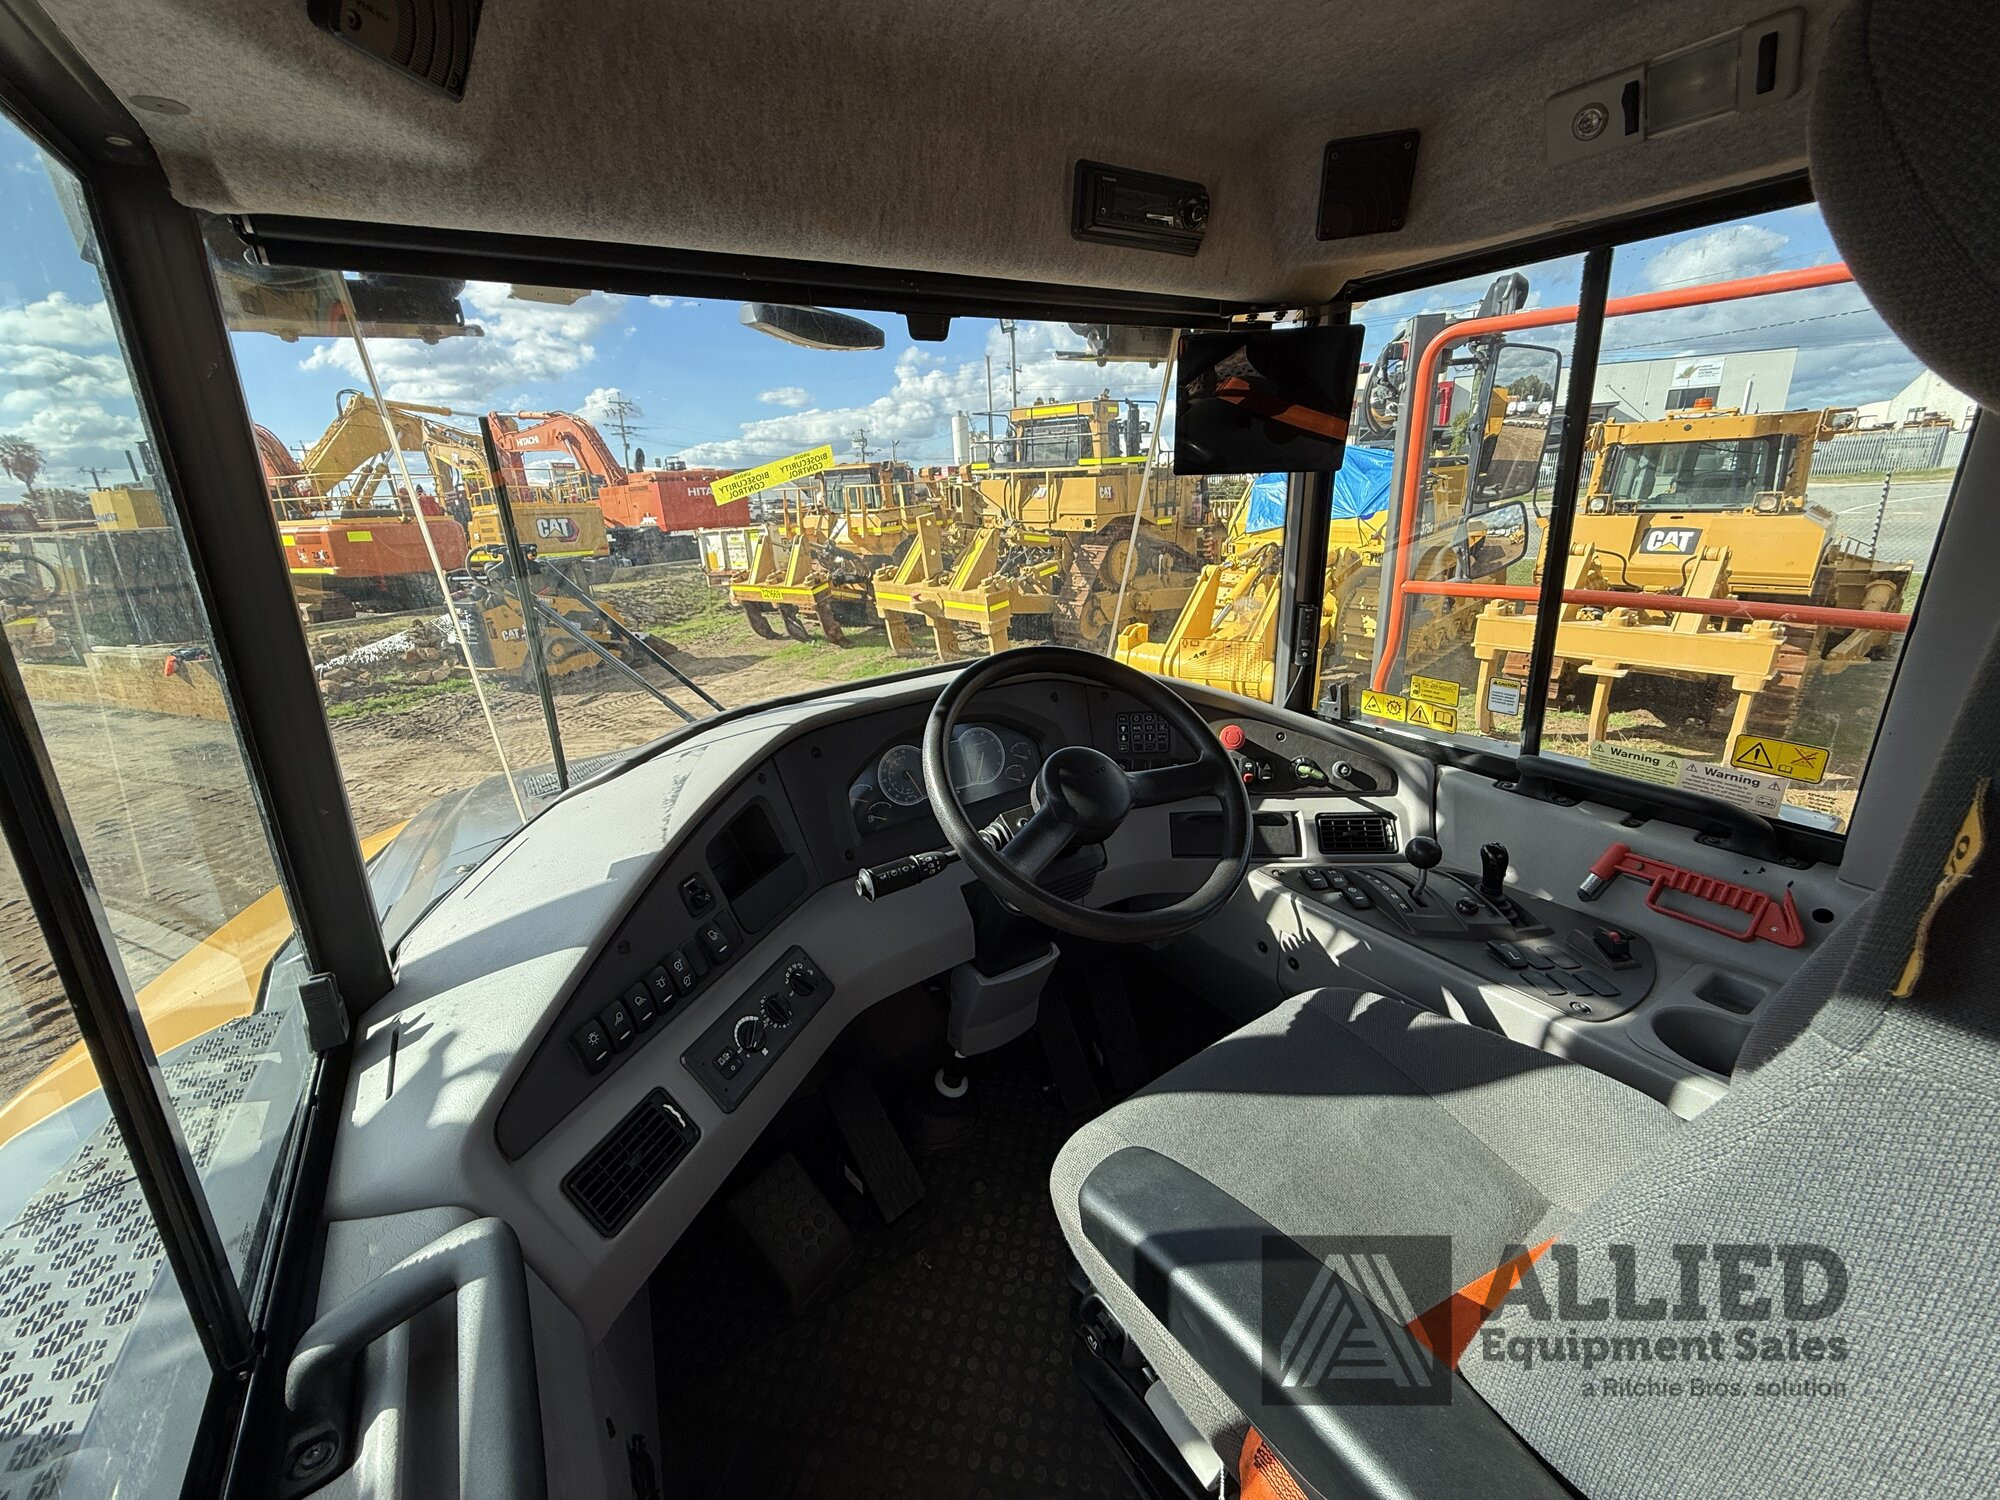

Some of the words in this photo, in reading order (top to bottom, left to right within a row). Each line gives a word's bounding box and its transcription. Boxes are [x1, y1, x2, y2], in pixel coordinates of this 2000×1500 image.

[516, 435, 539, 447] HITACHI
[687, 487, 714, 497] HITA
[1099, 486, 1112, 499] CAT
[536, 518, 569, 538] CAT
[1646, 530, 1695, 552] CAT
[501, 628, 520, 641] CAT
[1610, 746, 1660, 767] Warning
[1704, 766, 1761, 789] Warning
